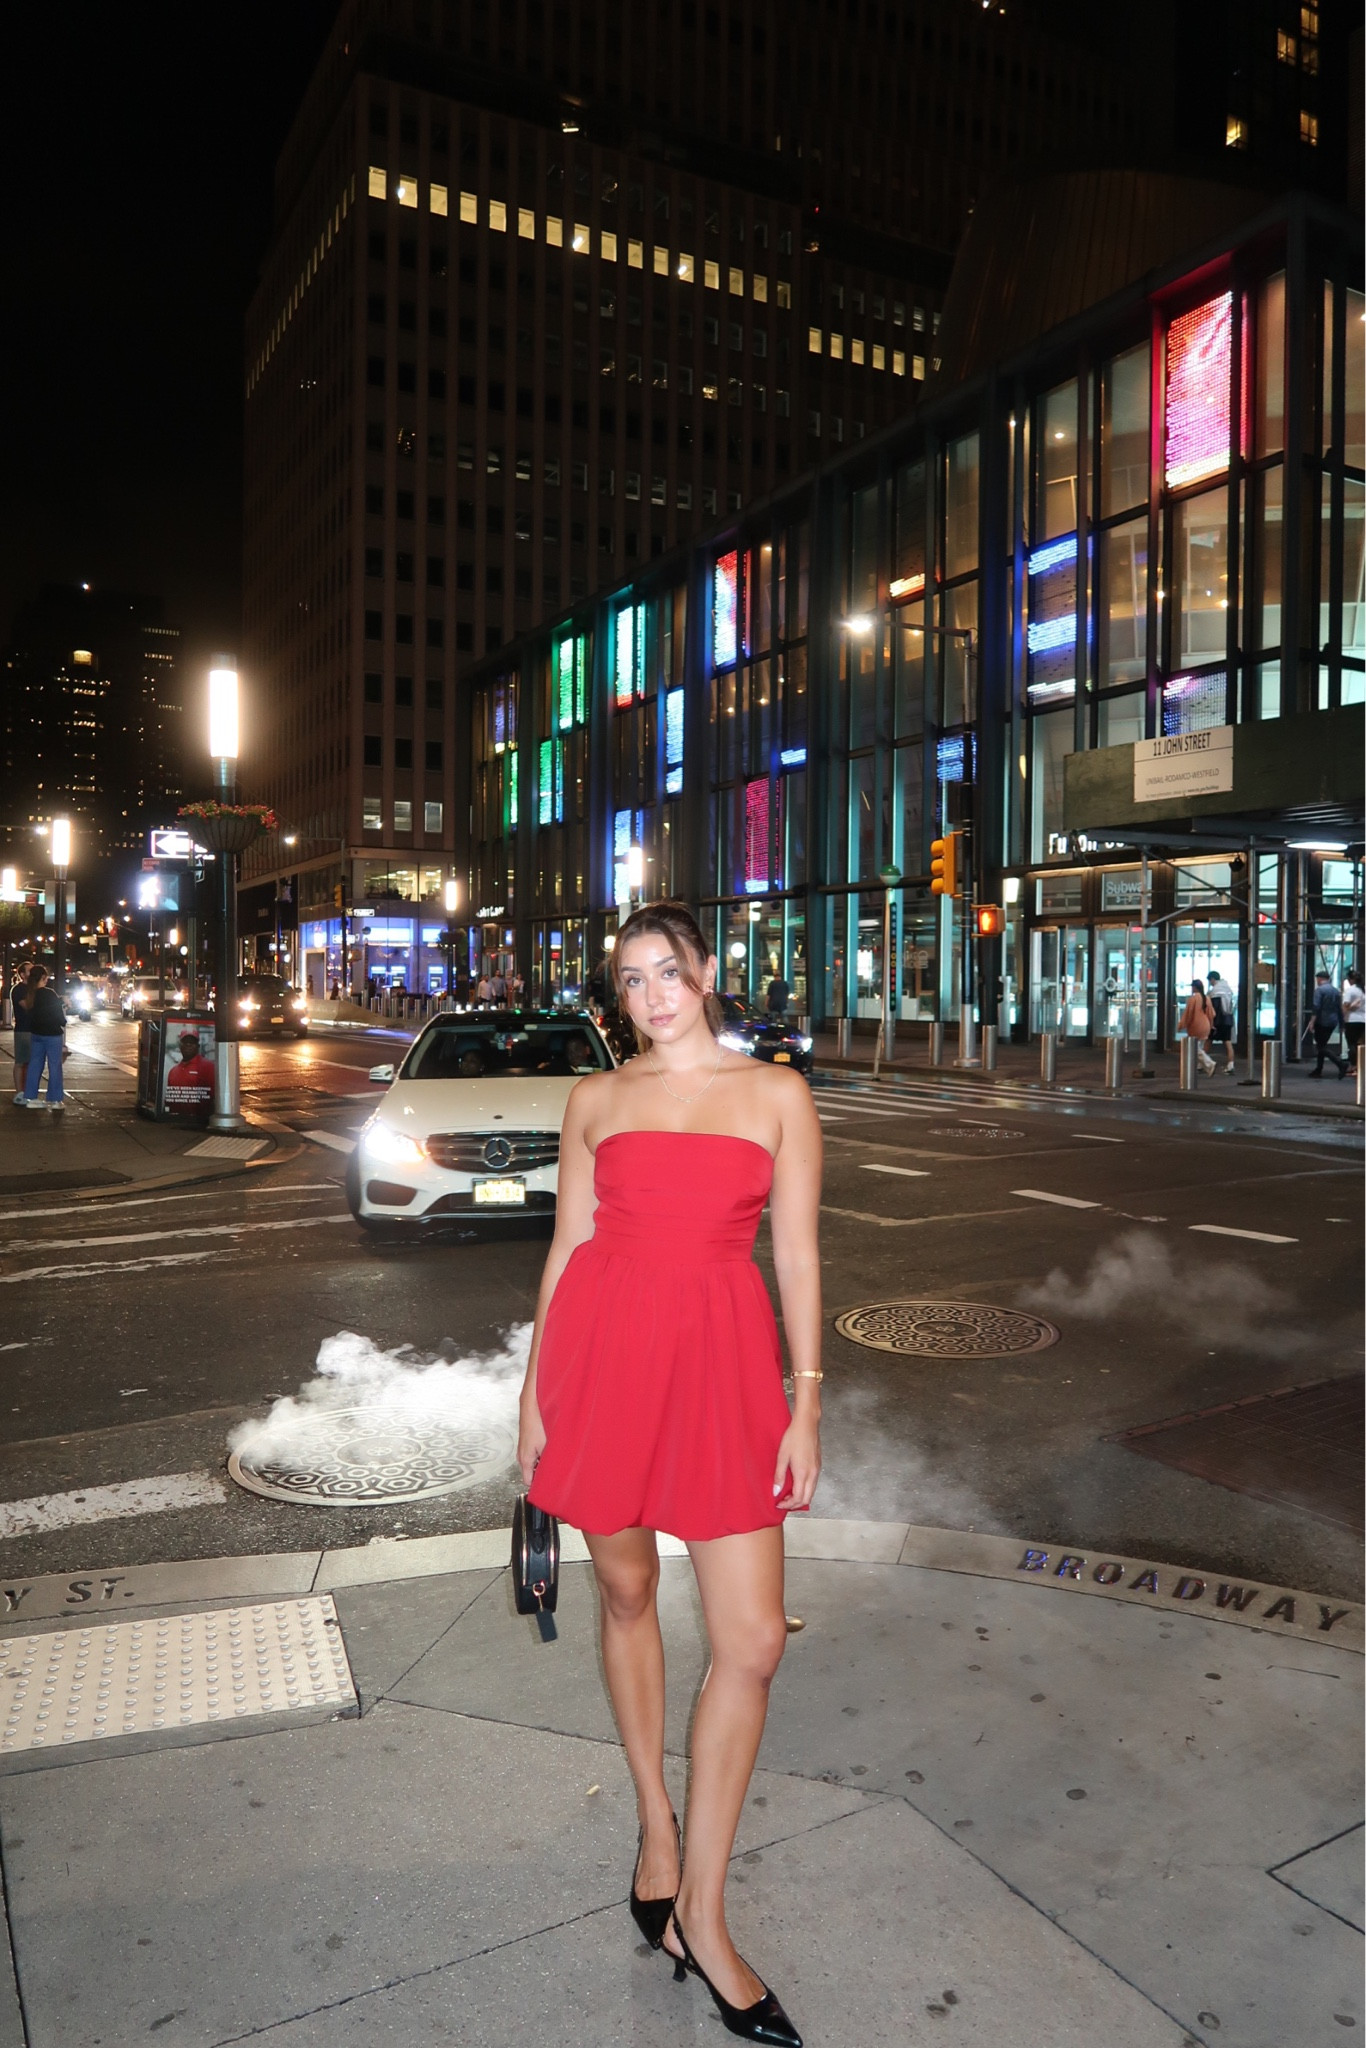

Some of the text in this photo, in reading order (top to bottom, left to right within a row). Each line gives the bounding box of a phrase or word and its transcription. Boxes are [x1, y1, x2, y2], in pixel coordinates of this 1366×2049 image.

[1153, 732, 1211, 757] 11 JOHN STREET
[1106, 880, 1143, 895] Subwa
[66, 1576, 135, 1604] ST.
[1018, 1548, 1349, 1632] BROADWAY
